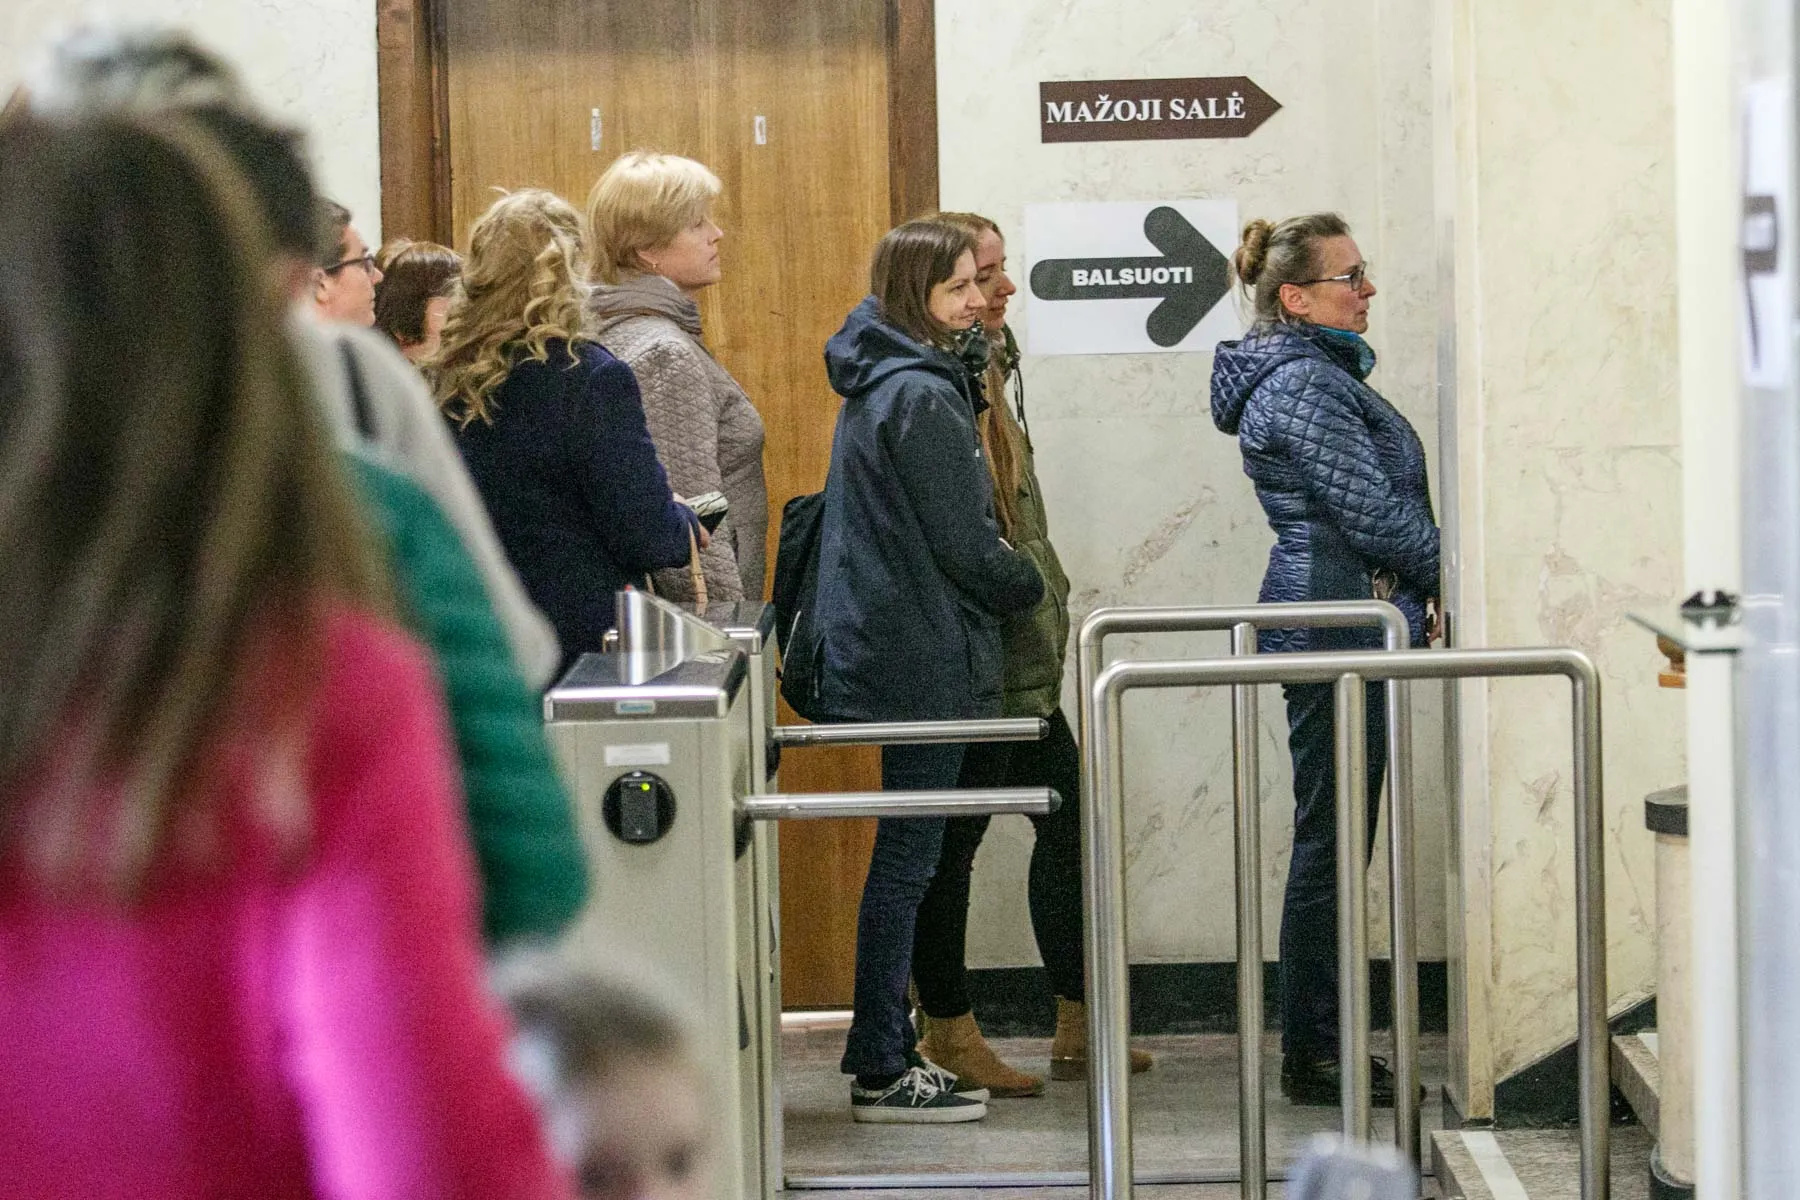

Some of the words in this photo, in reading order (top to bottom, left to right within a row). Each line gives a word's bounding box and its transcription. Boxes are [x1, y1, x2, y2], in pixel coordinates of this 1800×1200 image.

[1046, 94, 1162, 124] MAŽOJI
[1169, 91, 1246, 120] SALĖ
[1072, 266, 1193, 286] BALSUOTI
